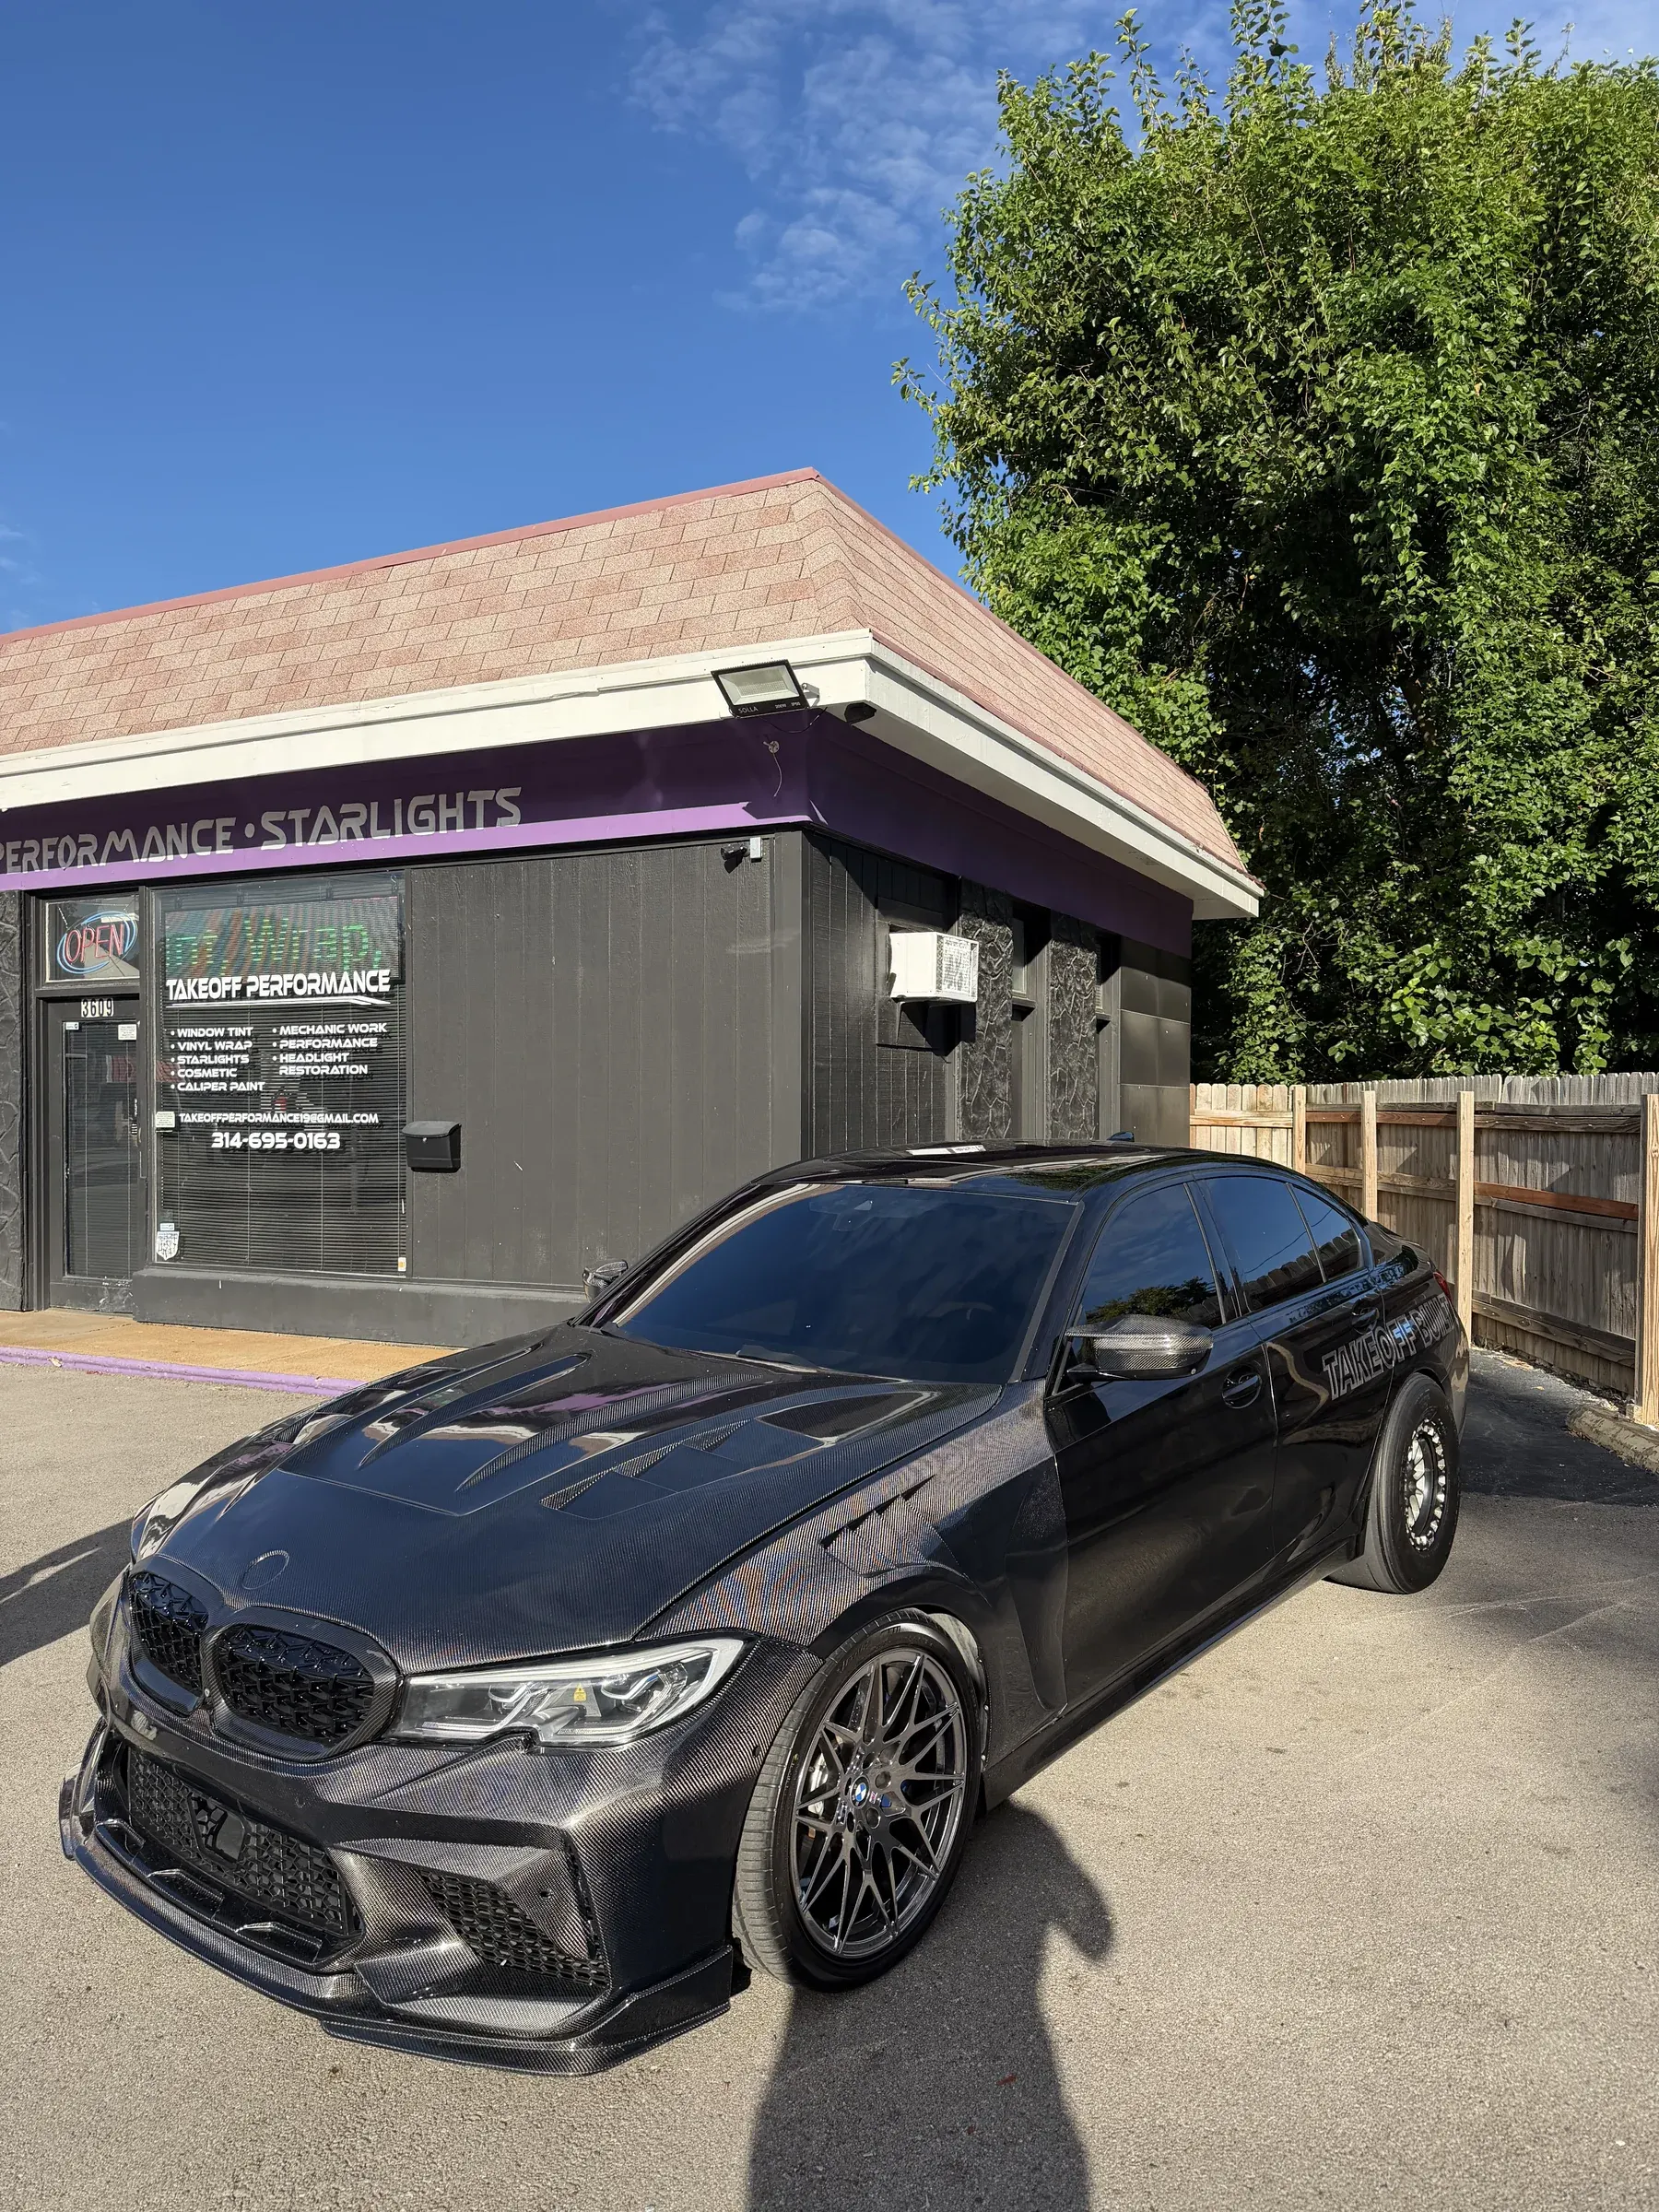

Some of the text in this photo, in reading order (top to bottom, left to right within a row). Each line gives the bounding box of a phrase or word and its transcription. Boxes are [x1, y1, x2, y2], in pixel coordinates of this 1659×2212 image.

[738, 706, 759, 714] SOLLA
[0, 786, 522, 873] ERFORMANCE STARLIGHTS
[65, 923, 125, 963] OPEN
[243, 919, 382, 971] Wrap,
[166, 969, 392, 1001] TAKEOFF PERFORMANCE
[81, 998, 113, 1018] 3609
[177, 1027, 253, 1038] WINDOW TINT
[279, 1022, 387, 1035] MECHANIC WORK
[177, 1041, 253, 1051] VINYL WRAP
[279, 1038, 378, 1049] PERFORMANCE
[177, 1054, 250, 1065] STARLIGHTS
[279, 1053, 349, 1063] HEADLIGHT
[177, 1068, 238, 1078] COSMETIC
[279, 1065, 368, 1075] RESTORATION
[177, 1081, 265, 1091] CALIPER PAINT
[179, 1112, 379, 1124] TAKEOFFPERFORMANCE19@GMAIL.COM
[211, 1132, 341, 1149] 314-695-0163
[1321, 1313, 1417, 1401] TAKEOFF
